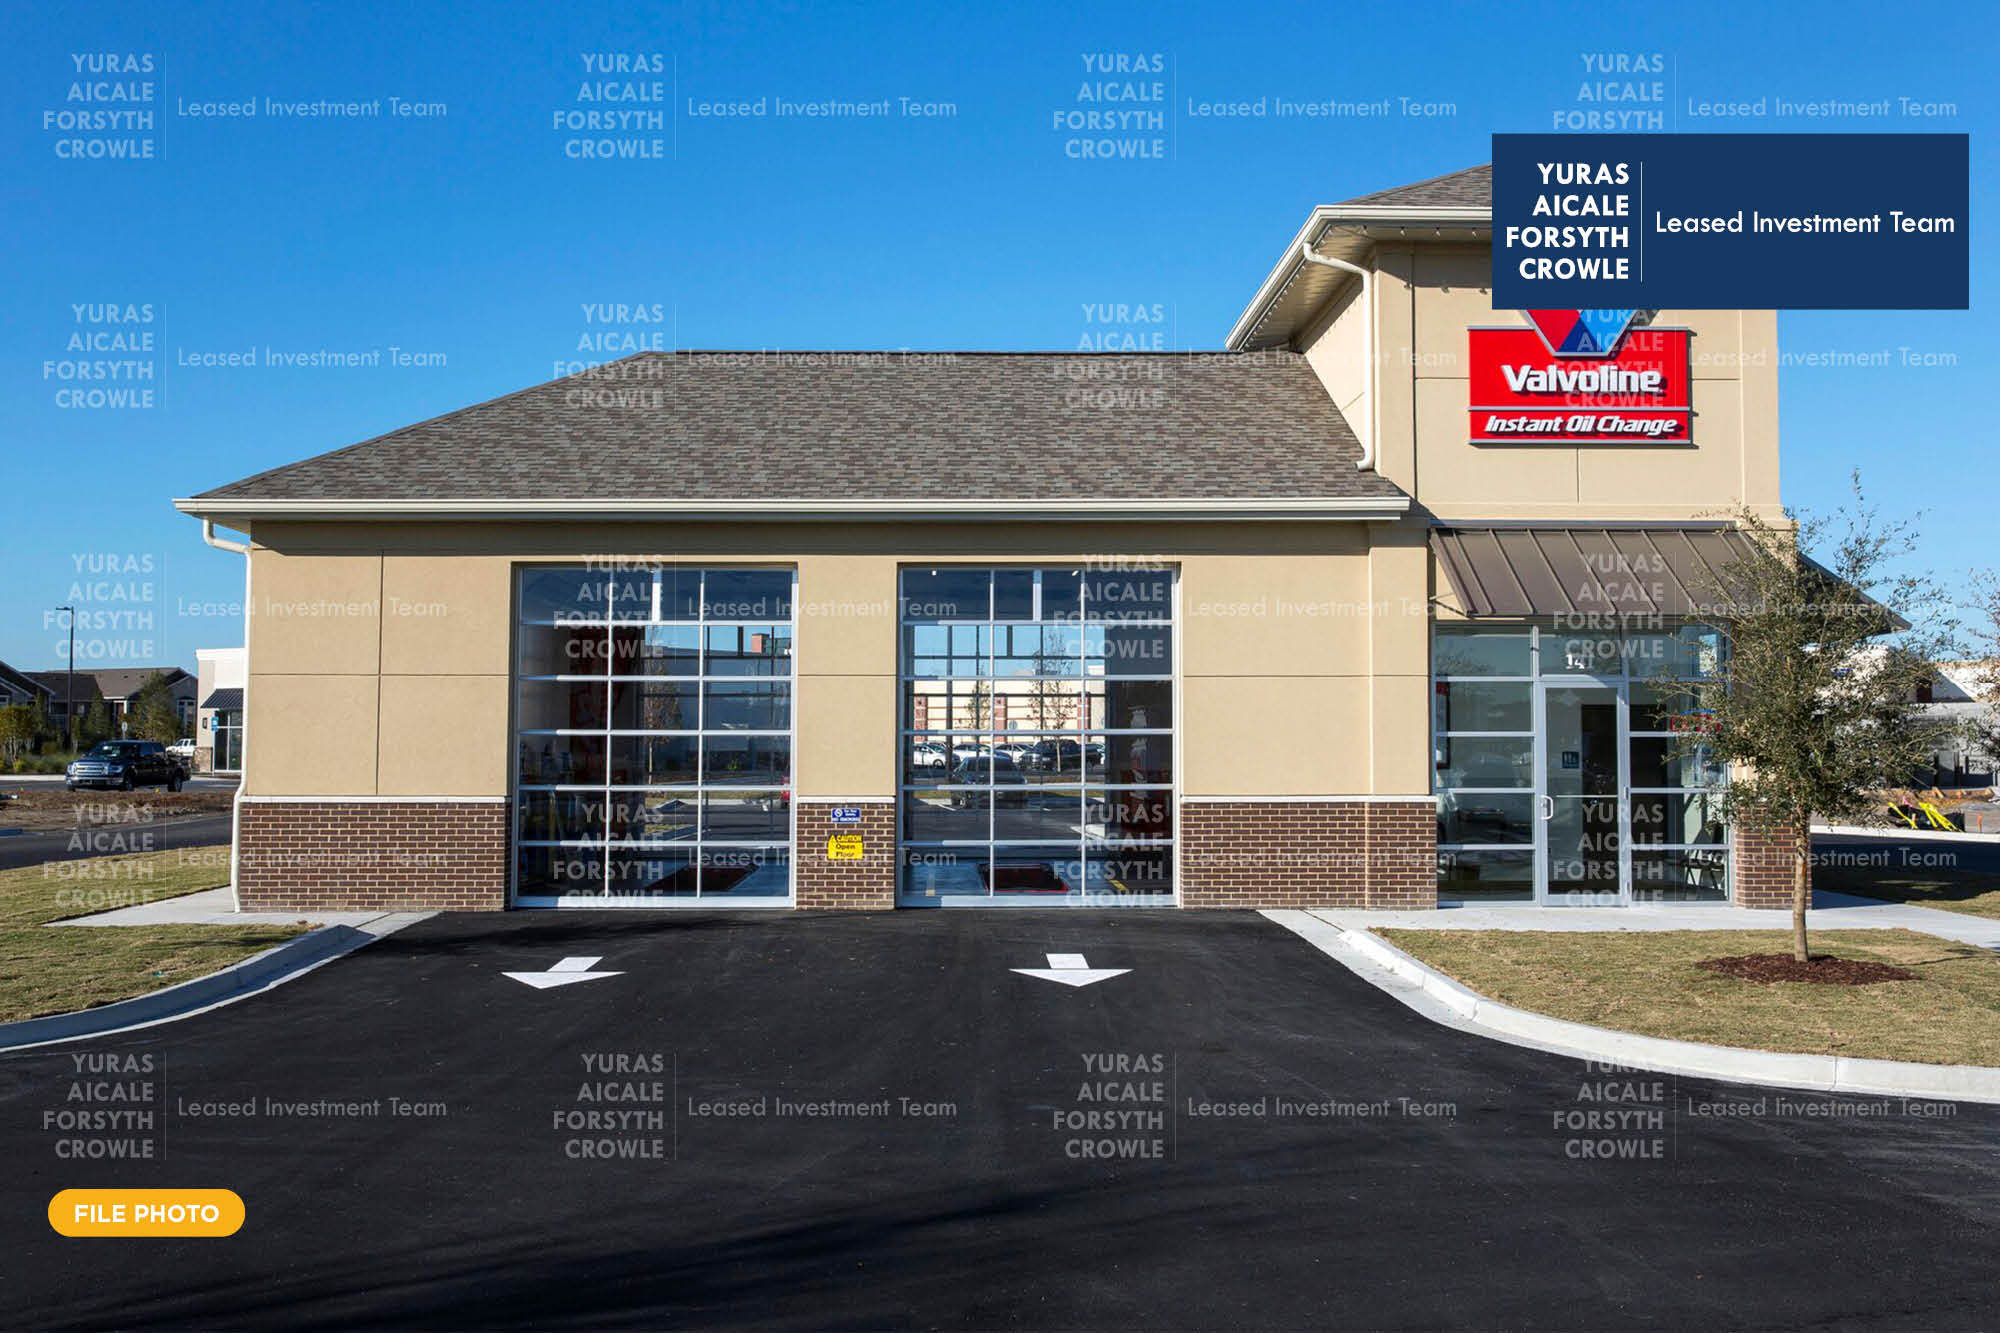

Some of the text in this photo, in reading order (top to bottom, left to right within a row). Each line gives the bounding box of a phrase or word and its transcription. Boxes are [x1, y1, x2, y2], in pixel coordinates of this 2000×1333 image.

[1501, 365, 1662, 392] Valvoline
[1485, 415, 1678, 436] Instant Oil Change
[836, 843, 856, 851] Open
